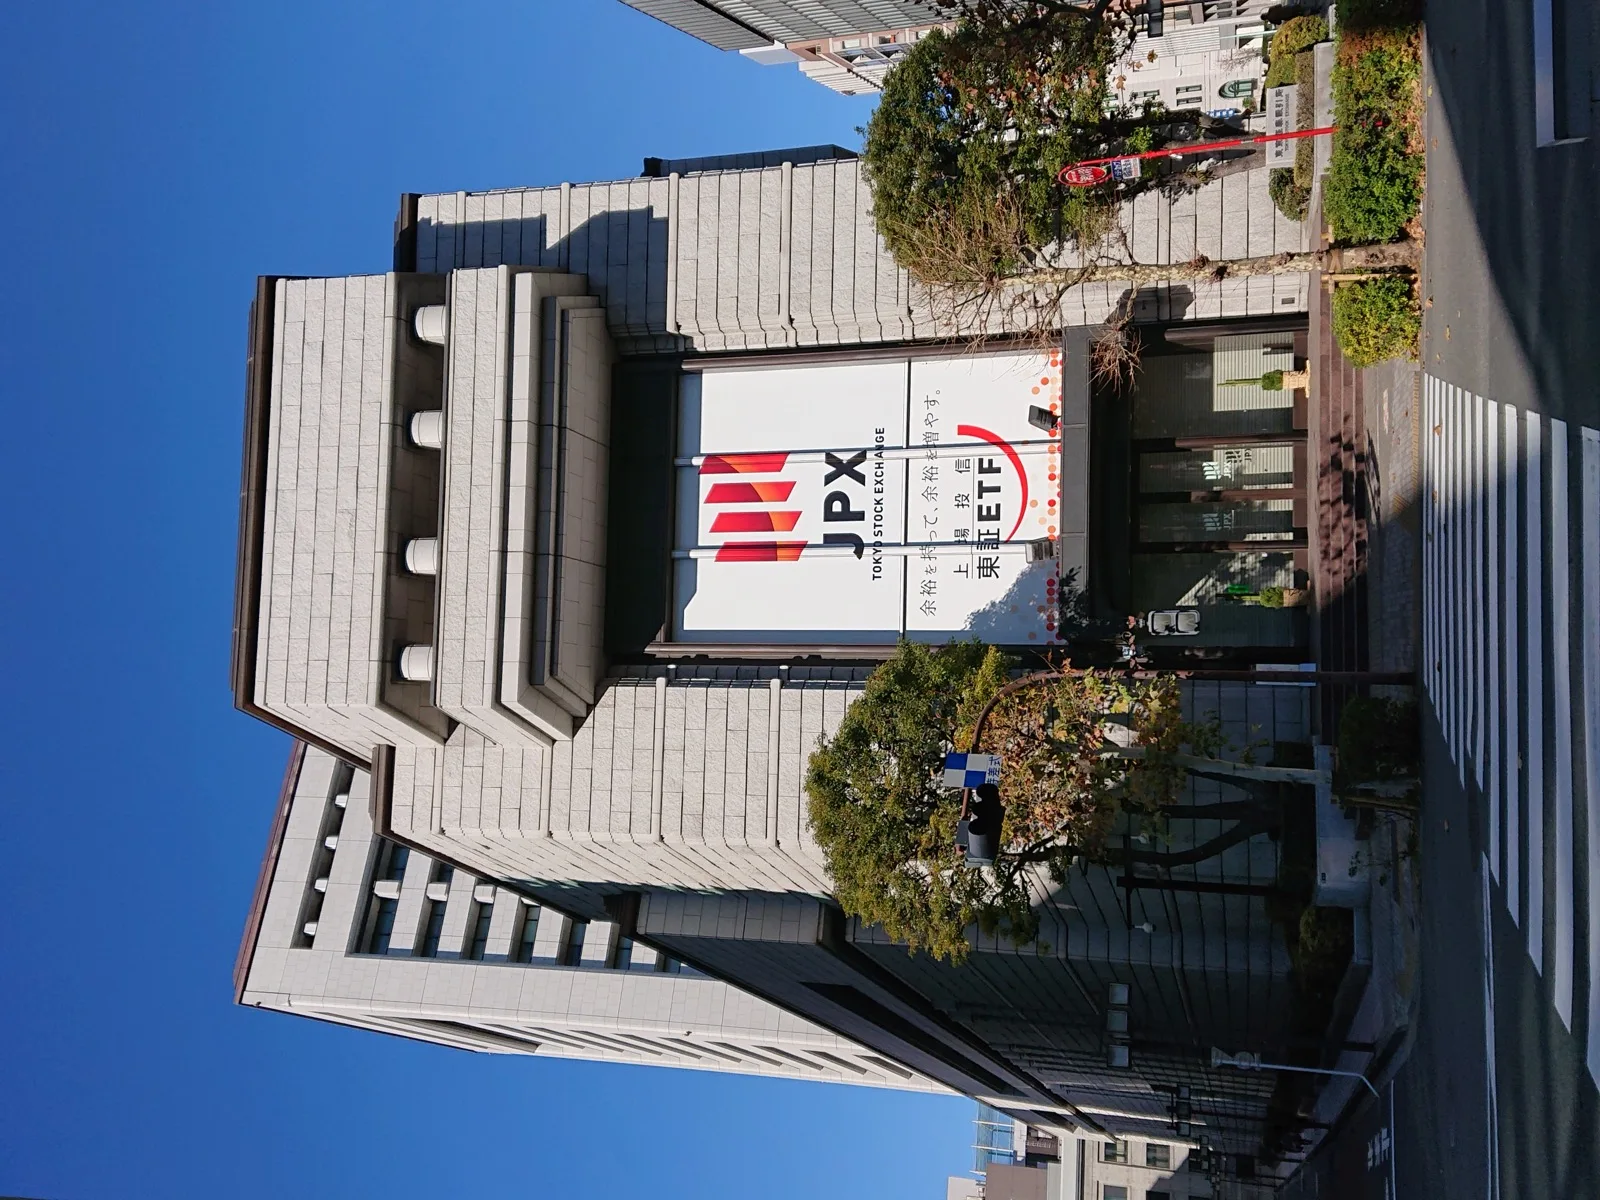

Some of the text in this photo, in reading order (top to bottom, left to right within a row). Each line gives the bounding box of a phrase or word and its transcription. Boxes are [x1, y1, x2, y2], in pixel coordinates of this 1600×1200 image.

[823, 450, 867, 560] JPX
[872, 428, 884, 580] TOKYO STOCK EXCHANGE
[954, 459, 970, 579] 上場投信
[976, 458, 1001, 579] 東証ETF
